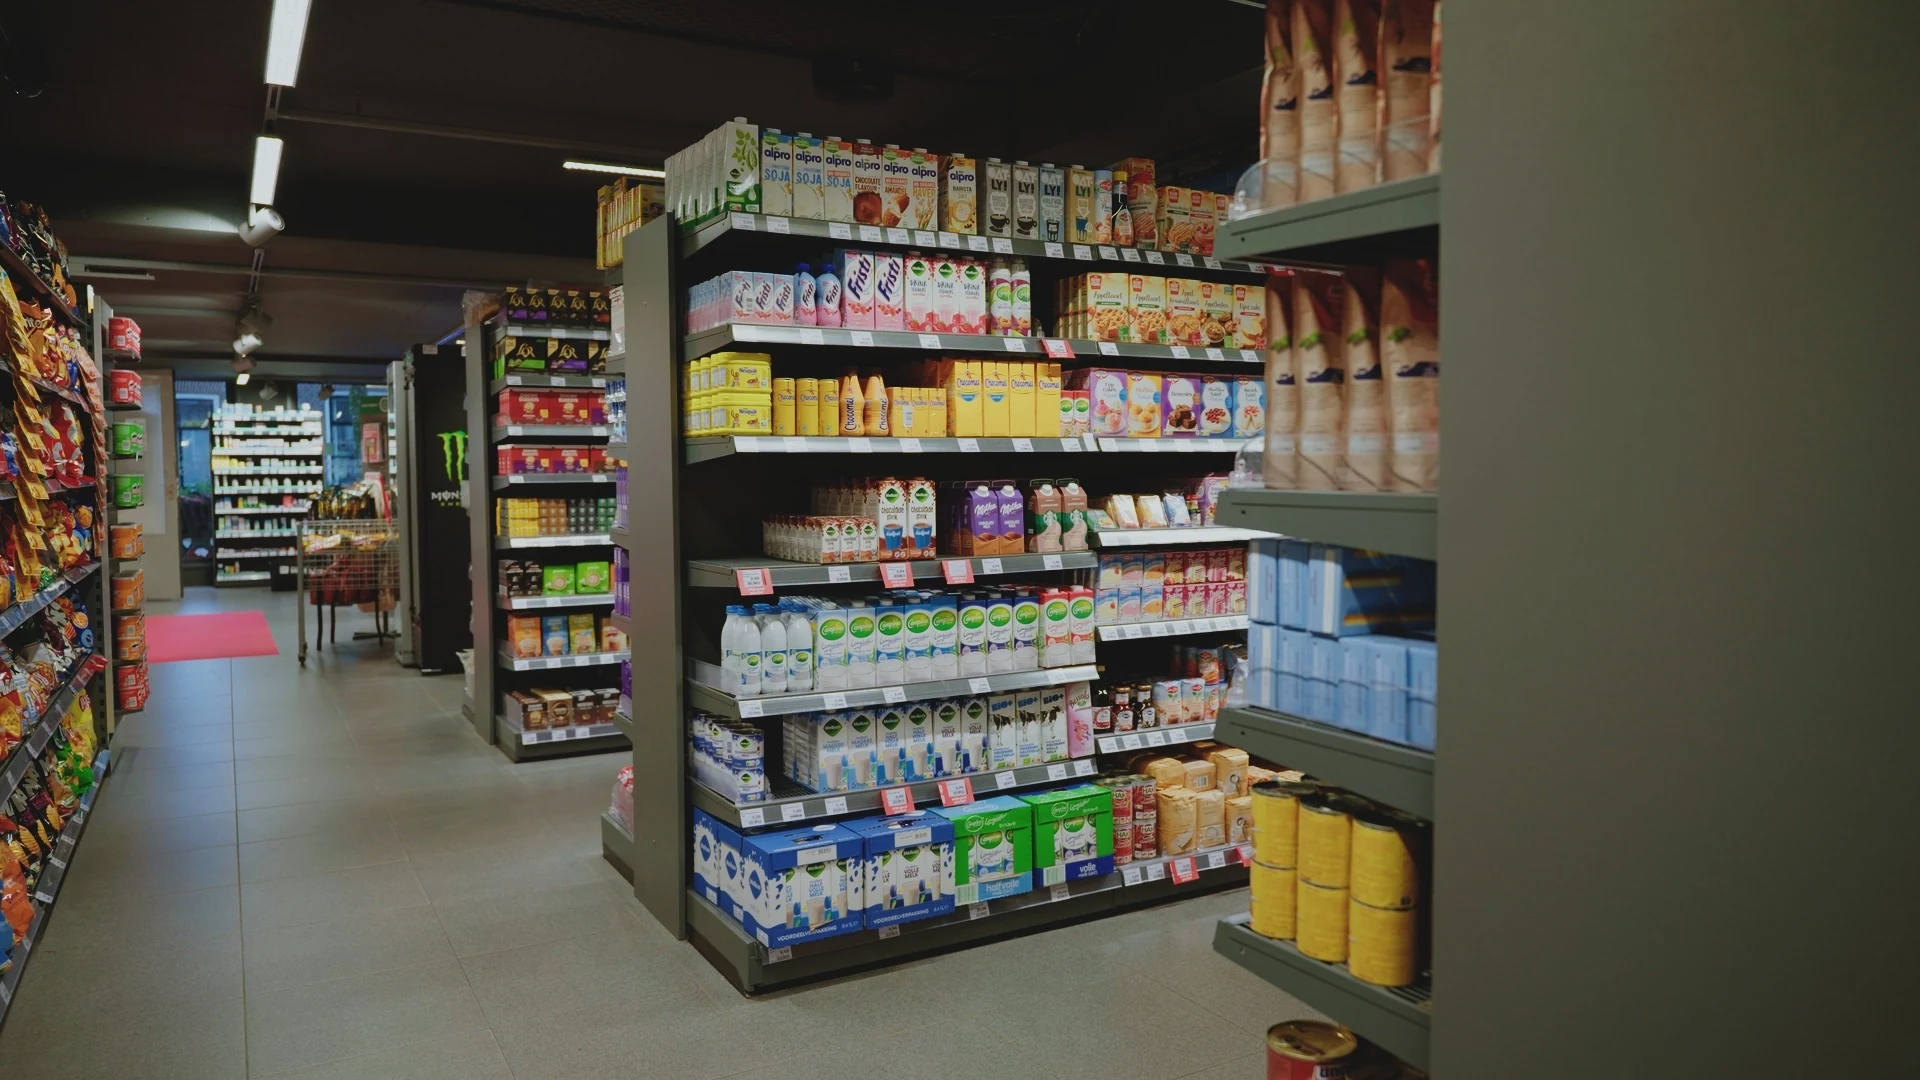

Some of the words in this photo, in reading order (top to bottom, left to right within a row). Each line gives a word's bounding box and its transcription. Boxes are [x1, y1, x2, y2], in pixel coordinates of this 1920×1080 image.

[764, 147, 790, 160] alpro
[796, 151, 821, 164] alpro
[826, 154, 851, 167] alpro
[855, 159, 880, 171] alpro
[884, 162, 908, 174] alpro
[912, 166, 936, 178] alpro
[765, 169, 790, 181] SOJA
[797, 172, 822, 184] SOJA
[950, 171, 974, 183] alpro
[827, 176, 850, 187] SOJA
[855, 177, 880, 185] CHOCOLATE
[992, 179, 1007, 191] LY!
[913, 188, 935, 198] HAVER
[1019, 182, 1034, 193] LY!
[1044, 185, 1060, 196] LY!
[1076, 186, 1090, 197] LY!
[848, 252, 871, 300] Fristi
[877, 255, 900, 302] Fristi
[756, 280, 771, 310] Fristi
[776, 282, 792, 311] Fristi
[802, 280, 814, 306] Fristi
[826, 281, 839, 304] Fristi
[957, 378, 979, 388] Chocomel
[985, 378, 1006, 388] Chocomel
[1012, 379, 1033, 388] Chocomel
[1039, 380, 1059, 389] Chocomel
[845, 398, 856, 430] Chocomel
[431, 490, 462, 501] MON
[881, 506, 904, 514] chocolade
[974, 503, 997, 516] Milka
[1000, 502, 1022, 516] Milka
[1047, 607, 1067, 617] Campina
[1072, 604, 1092, 614] Campina
[963, 615, 983, 624] Campina
[990, 612, 1009, 623] Campina
[1017, 610, 1037, 621] Campina
[880, 621, 901, 631] Campina
[908, 618, 929, 628] Campina
[933, 617, 955, 626] Campina
[822, 626, 845, 636] Campina
[851, 623, 873, 633] Campina
[1079, 863, 1096, 872] volle
[810, 880, 823, 888] HALF
[986, 879, 1019, 892] halfvolle
[809, 886, 824, 894] VOLLE
